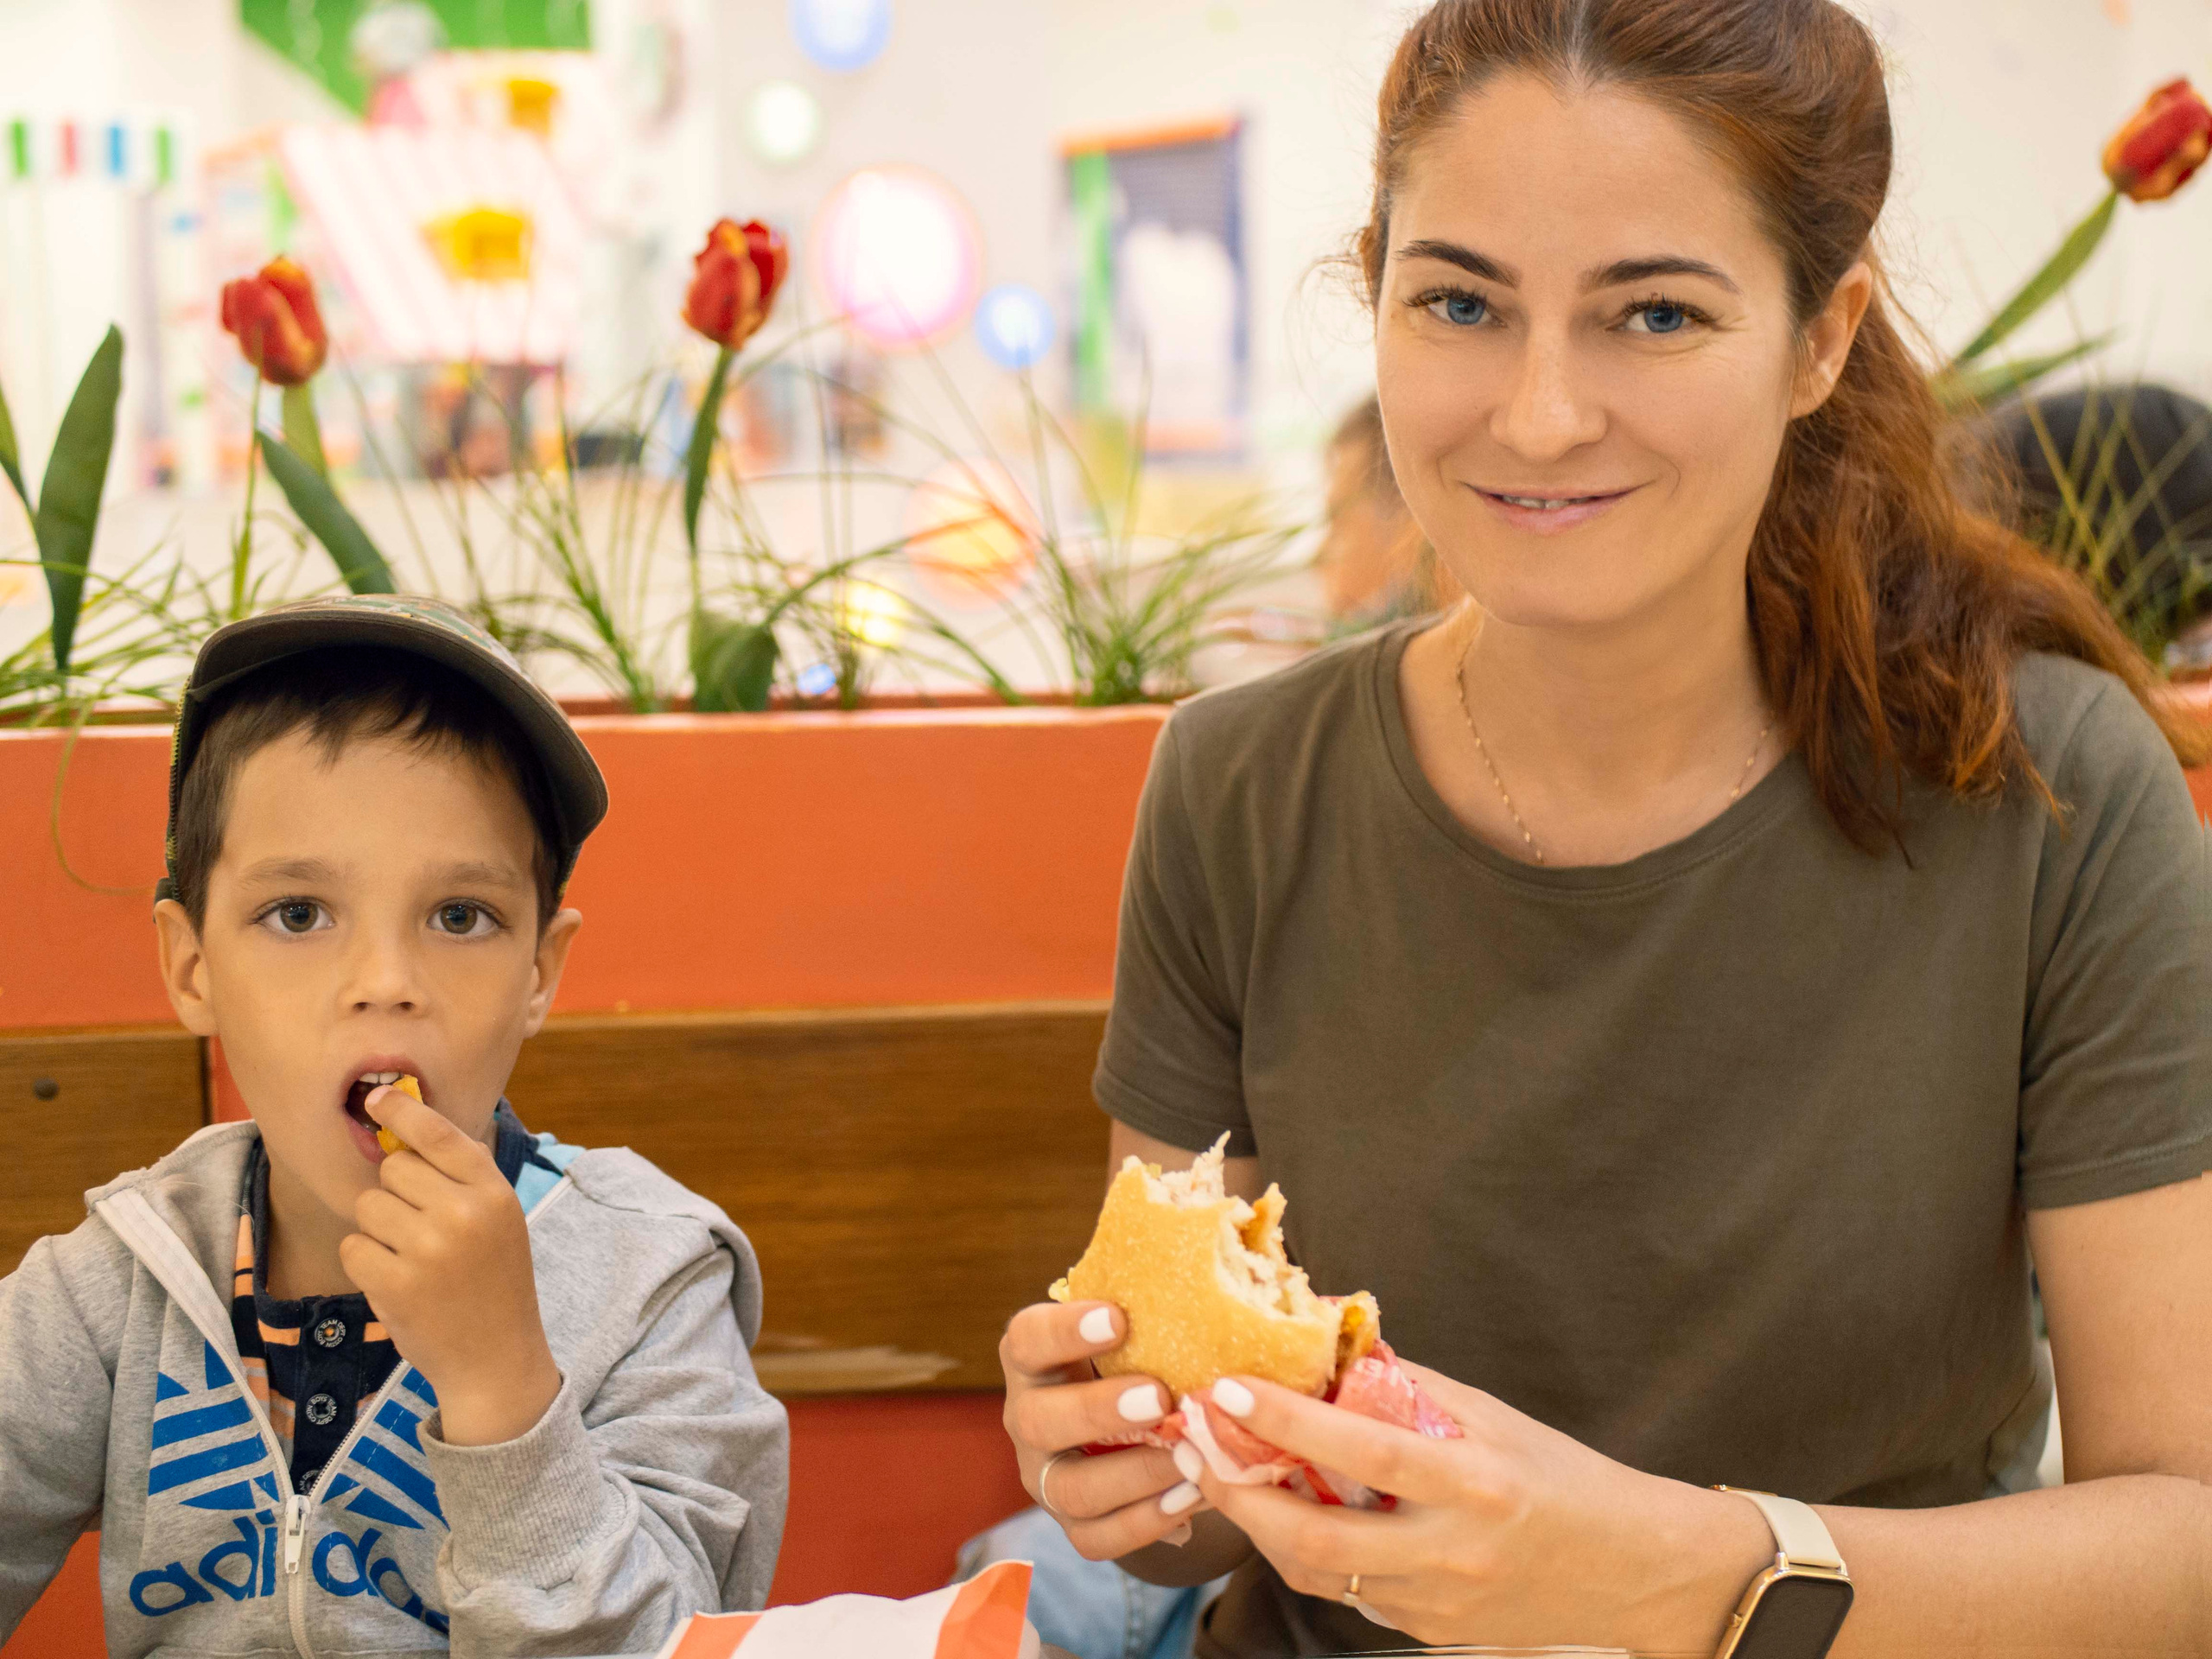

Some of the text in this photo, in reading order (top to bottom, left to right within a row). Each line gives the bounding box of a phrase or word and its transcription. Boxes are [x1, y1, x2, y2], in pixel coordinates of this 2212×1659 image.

[320, 1319, 338, 1329] TEAM
[338, 1322, 346, 1337] DEPT
[311, 1396, 327, 1405] BOYS
[328, 1399, 337, 1416] TEAM
[316, 1416, 333, 1425] DEPT
